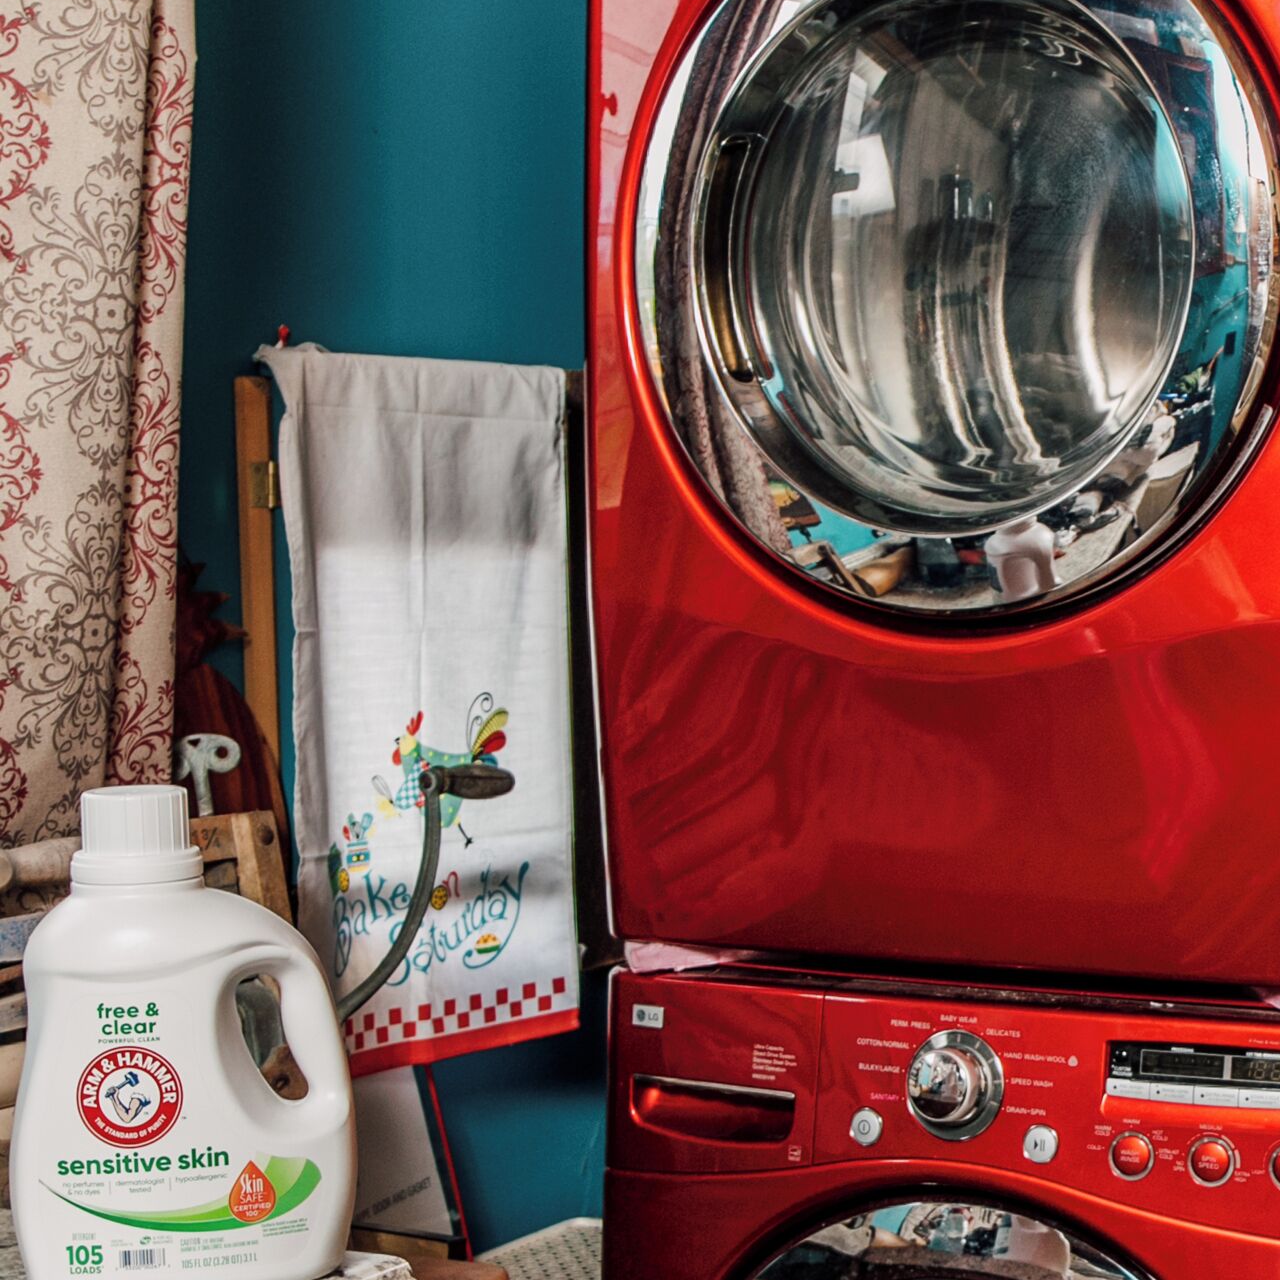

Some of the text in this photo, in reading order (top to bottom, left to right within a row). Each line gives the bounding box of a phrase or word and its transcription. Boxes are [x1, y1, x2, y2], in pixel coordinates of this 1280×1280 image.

[333, 871, 411, 979] Bake
[97, 1002, 159, 1019] free &
[101, 1020, 157, 1035] clear
[910, 1021, 930, 1030] PRESS
[986, 1028, 1021, 1038] DELICATES
[857, 1038, 909, 1049] COTTON/NORMAL
[1004, 1051, 1067, 1064] HAND WASH/WOOL
[82, 1051, 178, 1108] ARM & HAMMER
[1011, 1078, 1053, 1088] SPEED WASH
[870, 1092, 900, 1101] SANITARY
[104, 1125, 138, 1139] STANDARD
[138, 1128, 148, 1137] OF
[57, 1146, 229, 1176] sensitive skin
[115, 1178, 165, 1188] dermatologist
[175, 1173, 228, 1184] hypoallergenic
[240, 1174, 264, 1194] Skin
[72, 1181, 104, 1190] perfumes
[129, 1186, 151, 1194] tested
[84, 1189, 101, 1197] dyes
[240, 1193, 263, 1204] SAFE
[234, 1202, 272, 1212] CERTIFIED
[66, 1245, 104, 1266] 105
